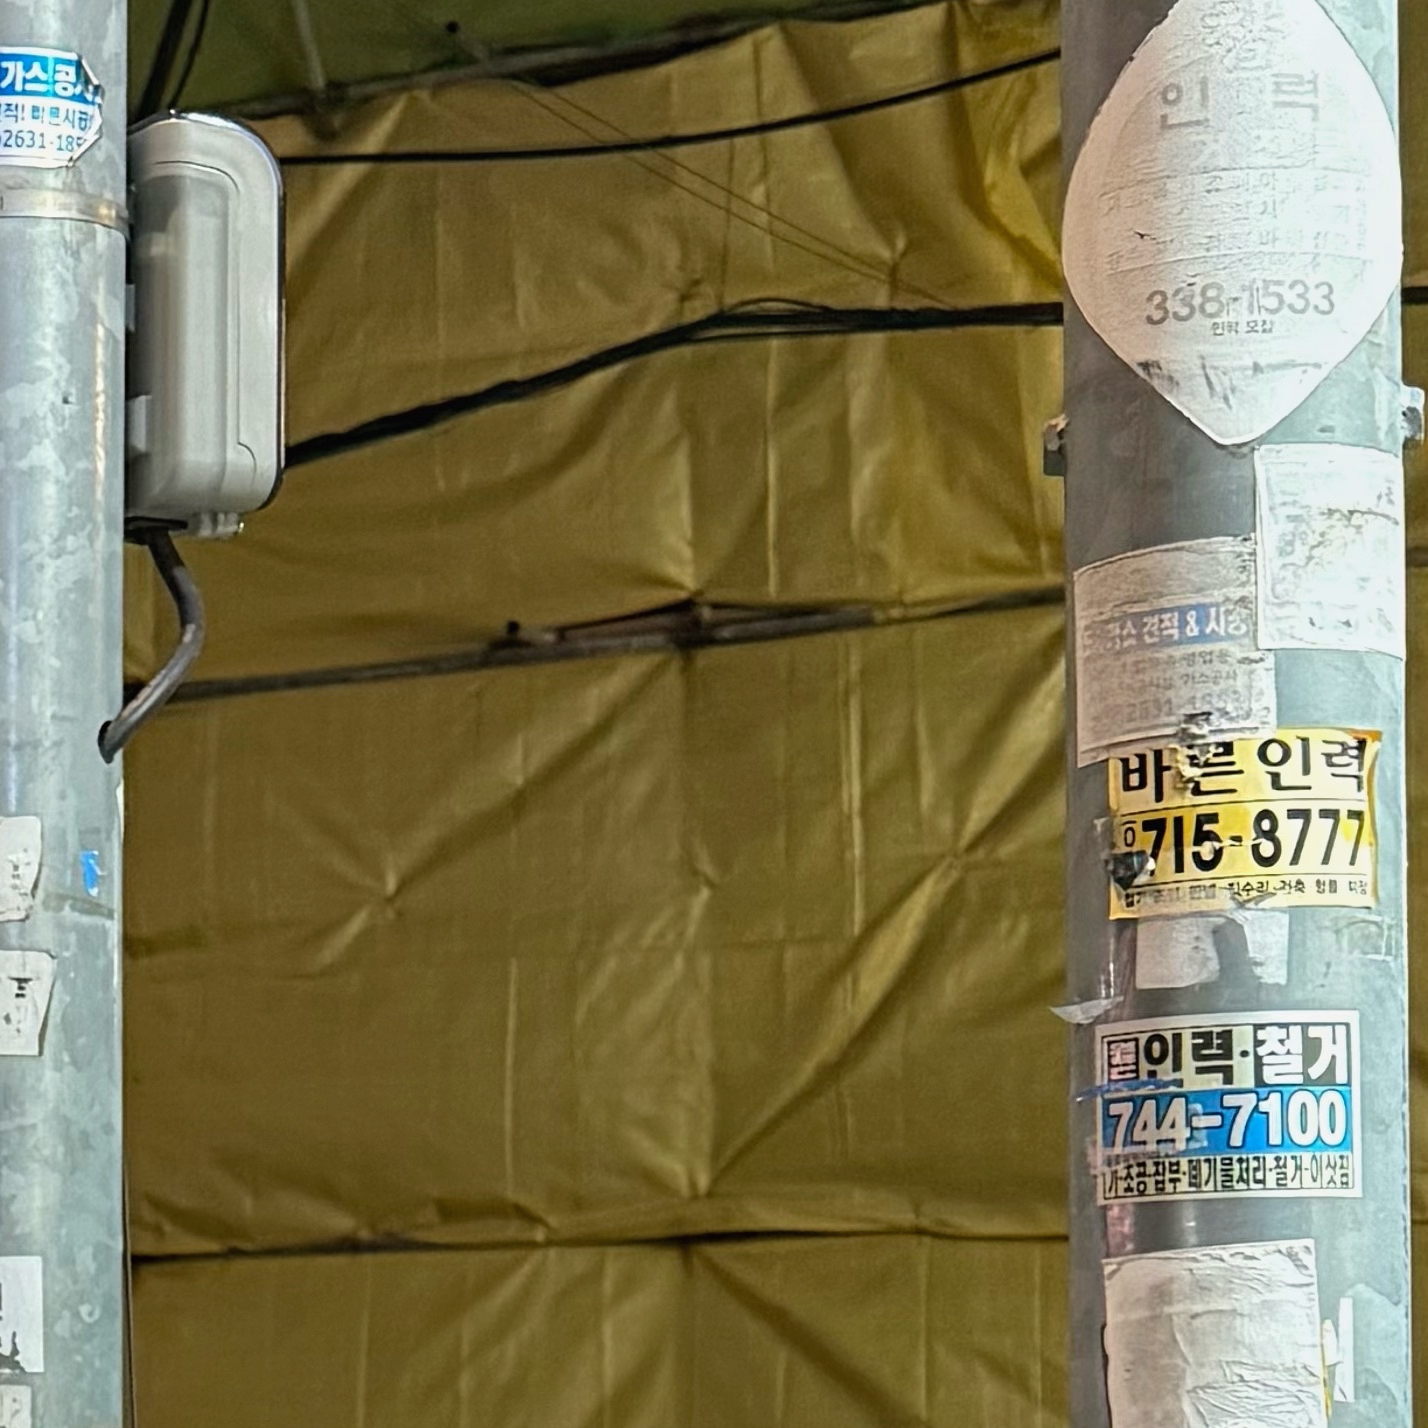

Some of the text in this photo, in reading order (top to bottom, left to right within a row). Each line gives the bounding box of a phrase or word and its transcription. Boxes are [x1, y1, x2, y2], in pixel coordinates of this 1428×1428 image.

[1257, 735, 1368, 795] 인력
[1142, 808, 1366, 878] 715-8777
[1108, 1090, 1347, 1155] 744-7100
